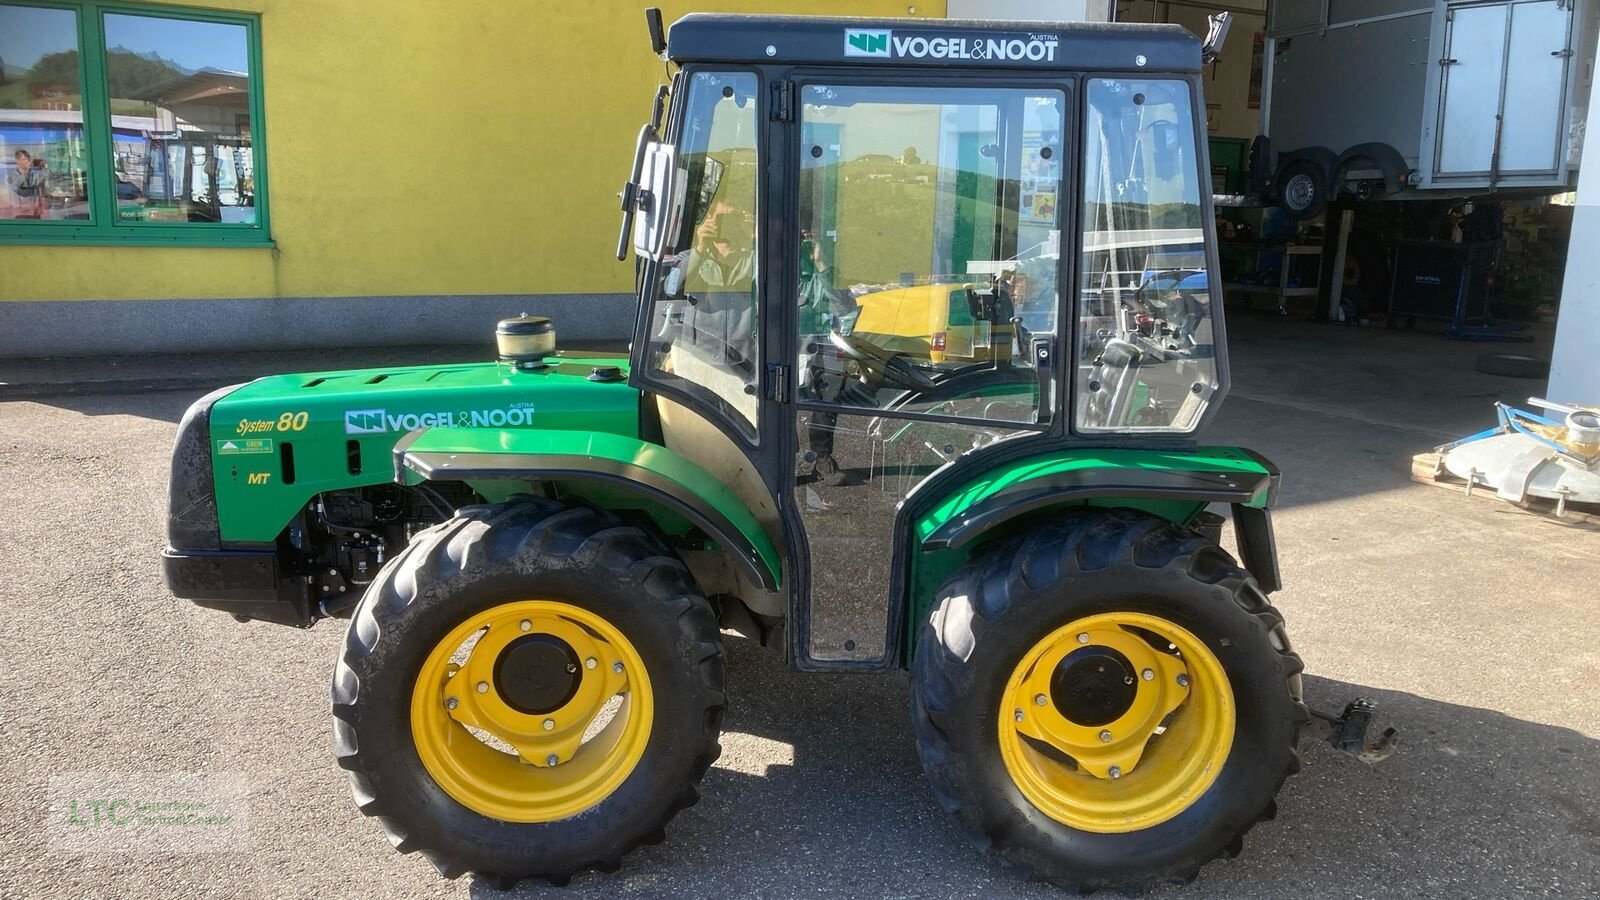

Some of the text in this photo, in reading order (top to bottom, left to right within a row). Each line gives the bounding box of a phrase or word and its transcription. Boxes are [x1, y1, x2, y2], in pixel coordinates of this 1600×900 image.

[236, 411, 309, 436] System 80
[247, 473, 271, 484] MT
